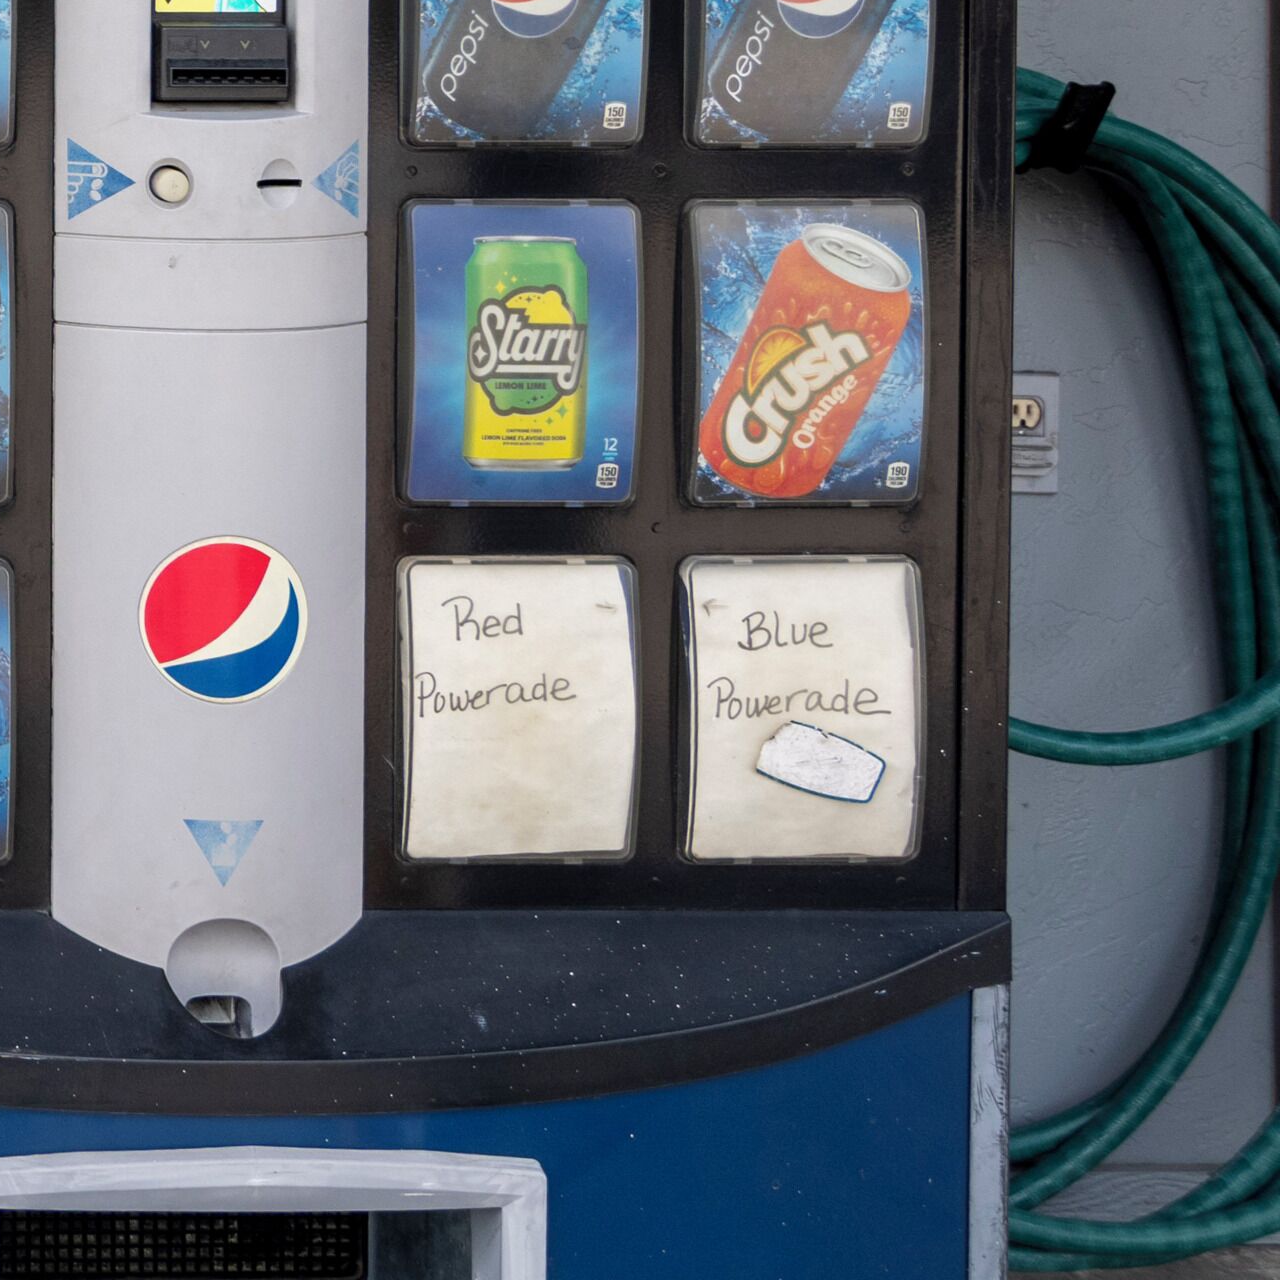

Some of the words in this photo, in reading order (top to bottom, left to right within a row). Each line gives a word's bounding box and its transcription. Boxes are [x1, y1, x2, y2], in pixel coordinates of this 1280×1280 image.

[440, 9, 489, 102] pepsi
[725, 10, 774, 103] pepsi
[607, 106, 624, 117] 150
[892, 106, 909, 117] 150
[469, 304, 585, 390] Starry
[495, 382, 524, 390] LEMON
[527, 382, 546, 390] LIME
[725, 323, 870, 464] Crush
[792, 374, 858, 449] Orange
[604, 437, 618, 451] 12
[600, 466, 617, 477] 150
[890, 465, 907, 476] 190
[441, 595, 524, 641] Red
[737, 610, 834, 651] Blue
[415, 671, 577, 718] Powerade
[707, 676, 892, 720] Powerade
